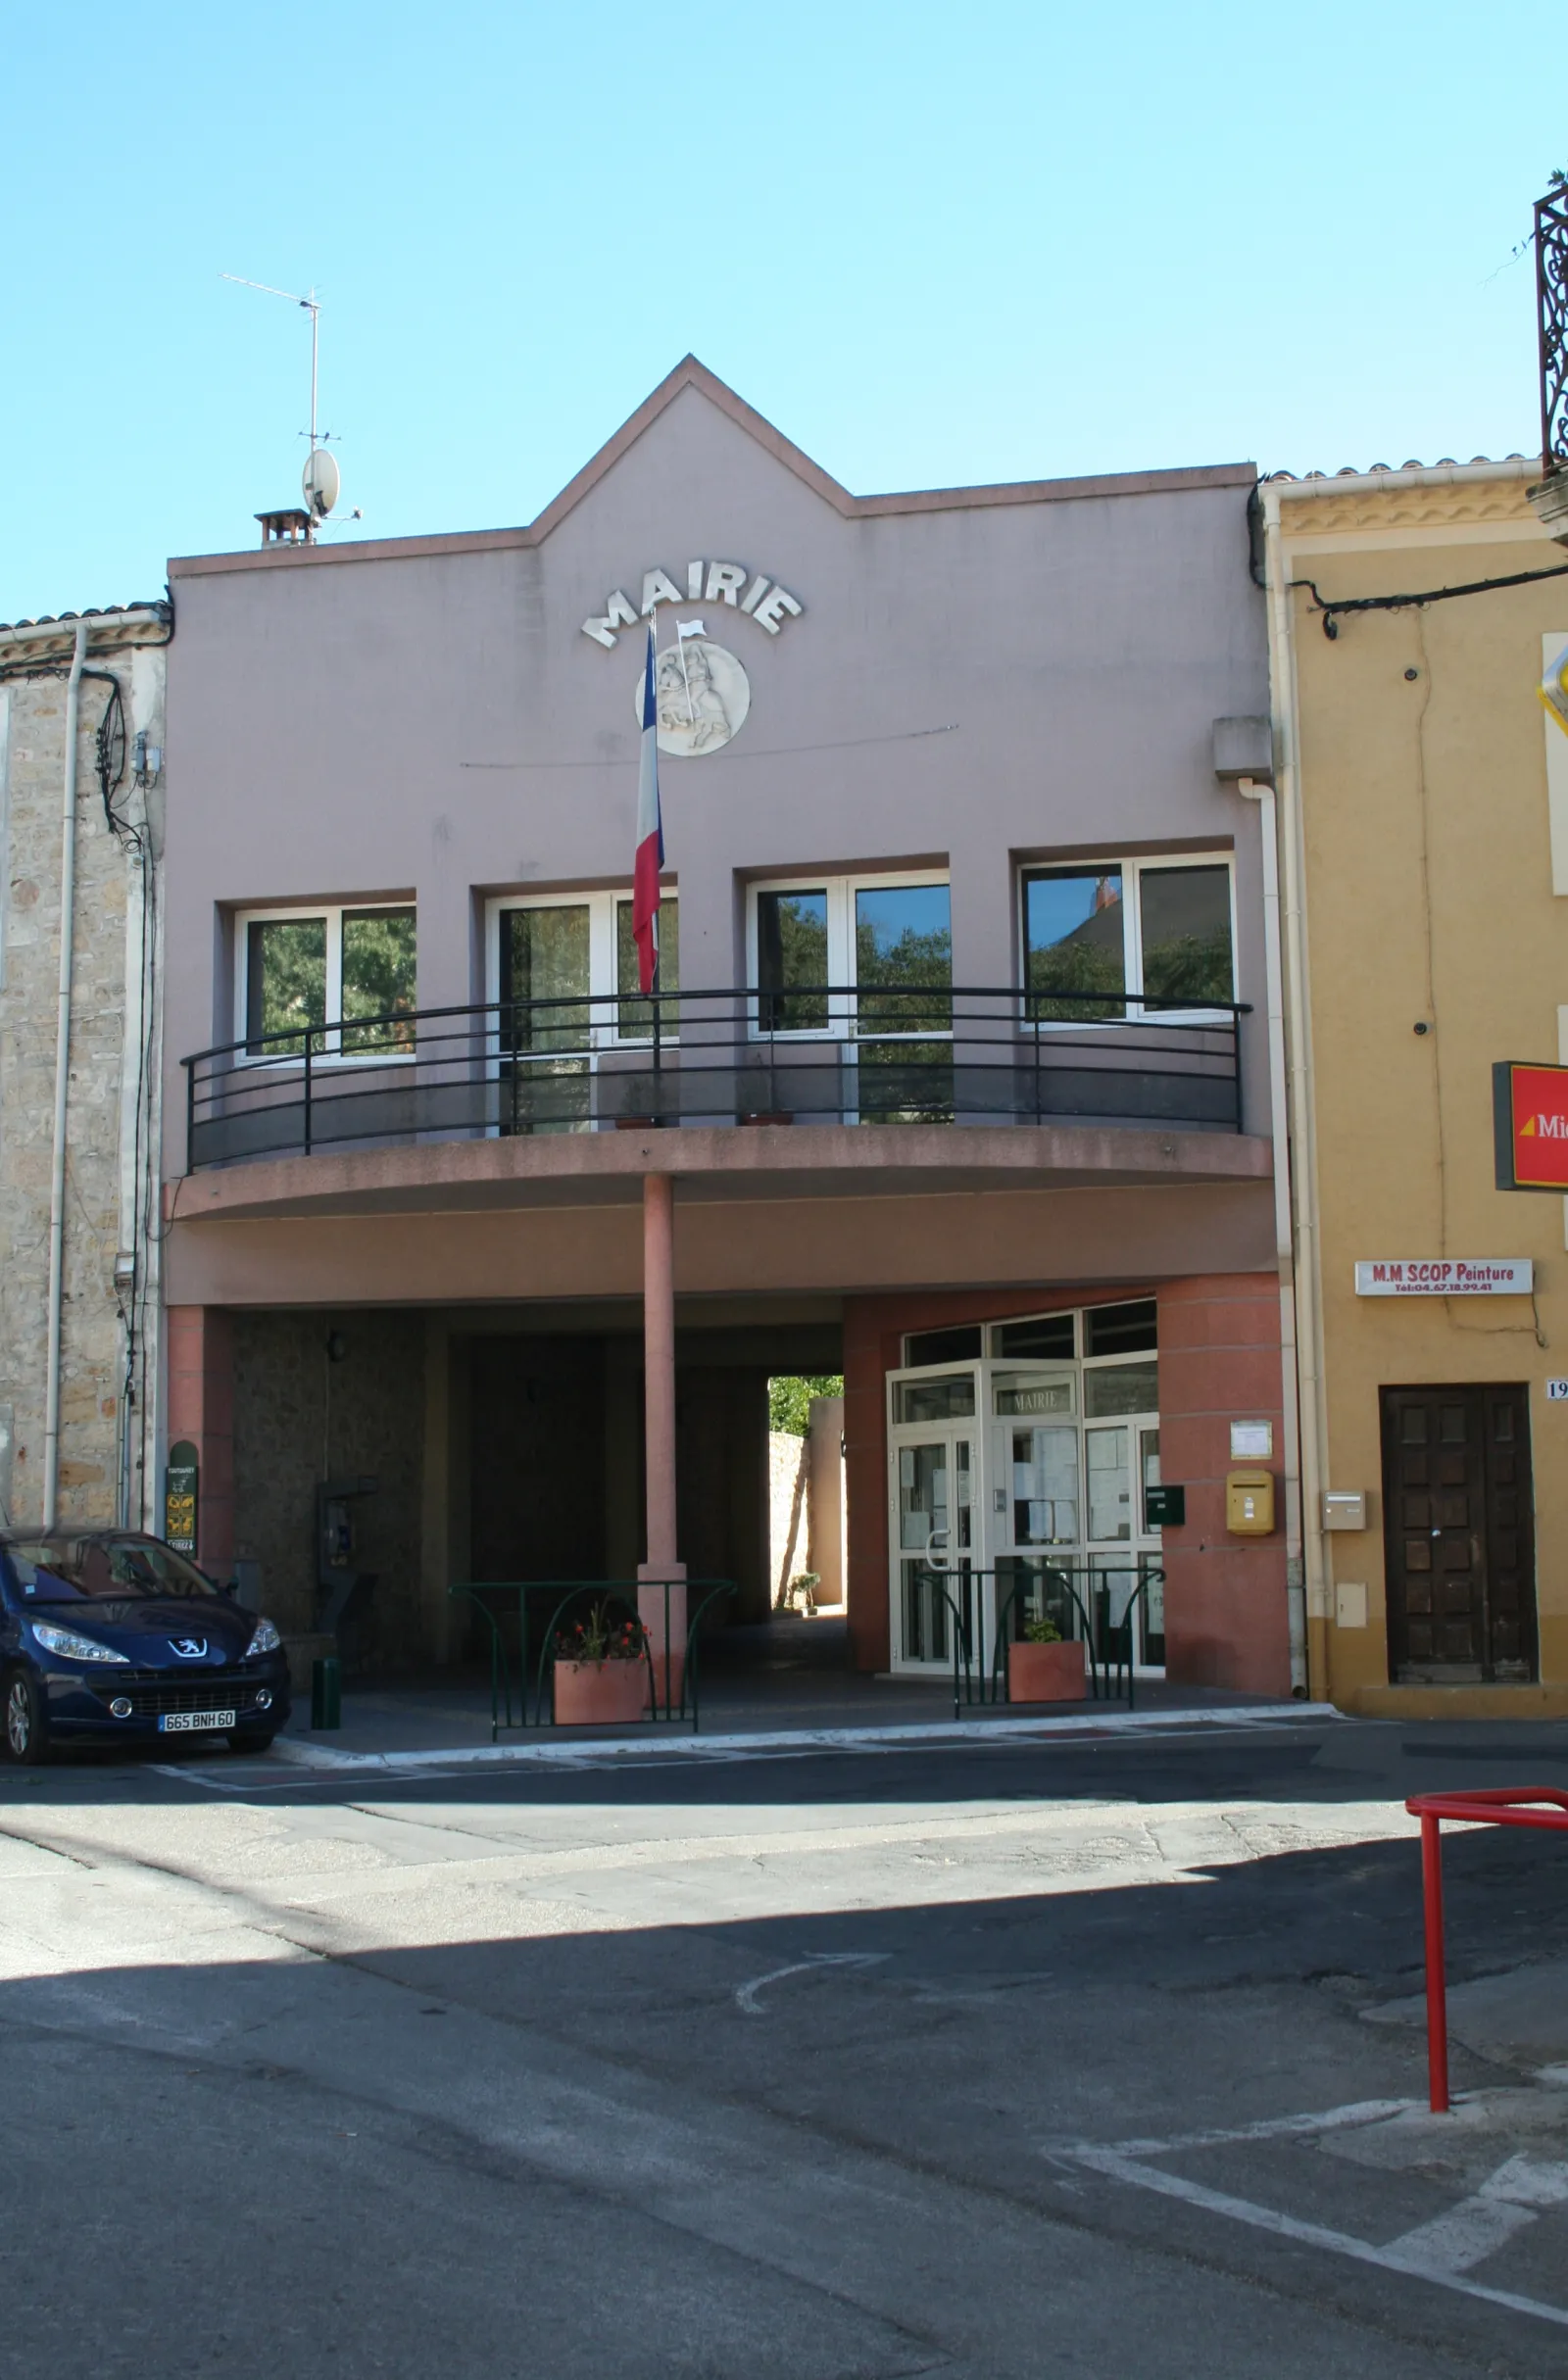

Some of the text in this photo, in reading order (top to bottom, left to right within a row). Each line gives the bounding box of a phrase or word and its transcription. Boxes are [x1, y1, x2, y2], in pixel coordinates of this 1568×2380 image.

[581, 560, 803, 649] MAIRIE
[1373, 1263, 1514, 1282] M.M SCOP Peinture
[1550, 1382, 1568, 1397] 19
[1014, 1390, 1057, 1411] MAIRIE
[167, 1712, 233, 1729] 665 BNH 60
